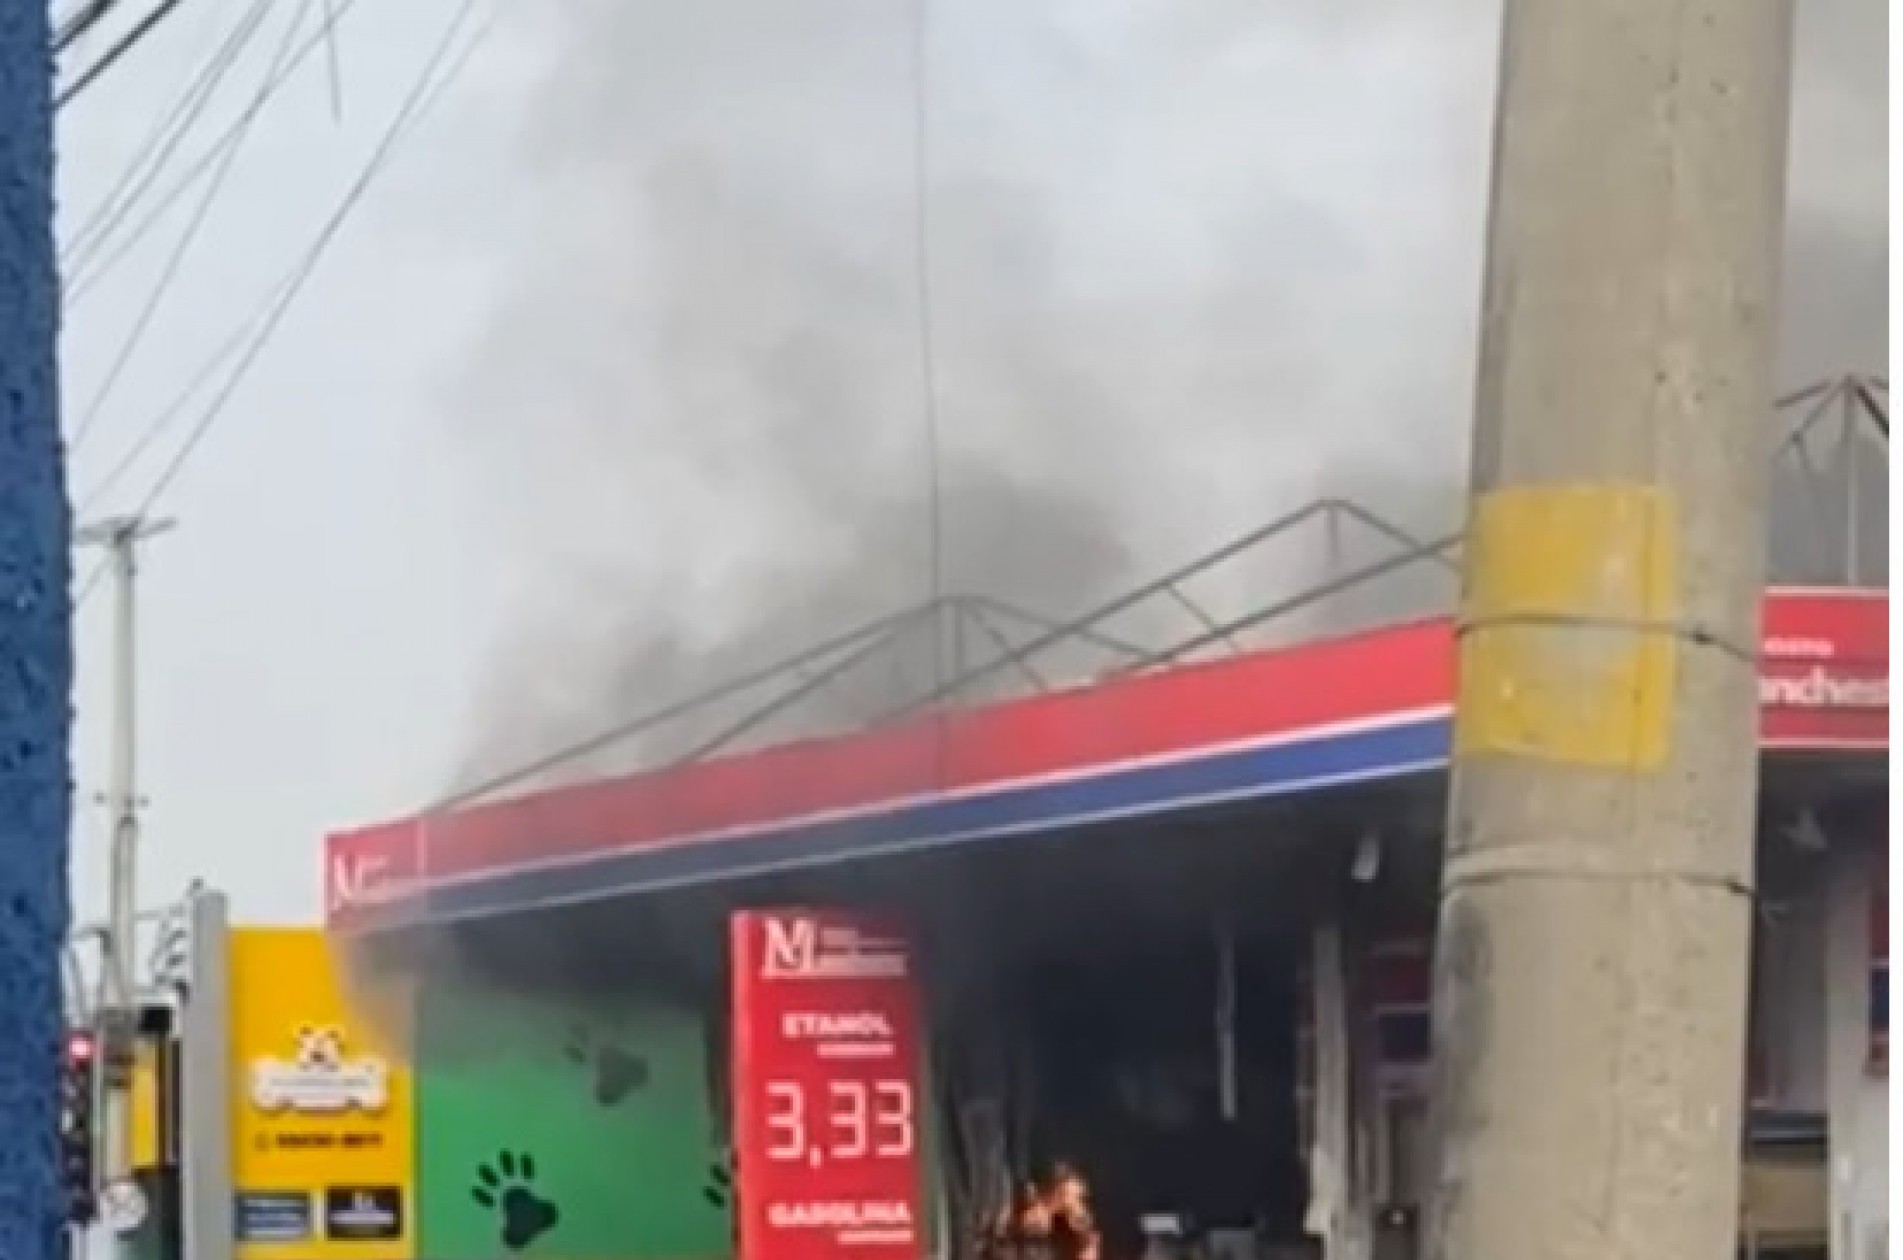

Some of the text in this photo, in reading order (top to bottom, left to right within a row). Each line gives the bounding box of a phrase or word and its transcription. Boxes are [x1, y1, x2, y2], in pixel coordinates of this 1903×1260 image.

[781, 1010, 894, 1039] ETANOL
[764, 1079, 914, 1168] 3,33
[768, 1200, 914, 1228] GASOLINA
